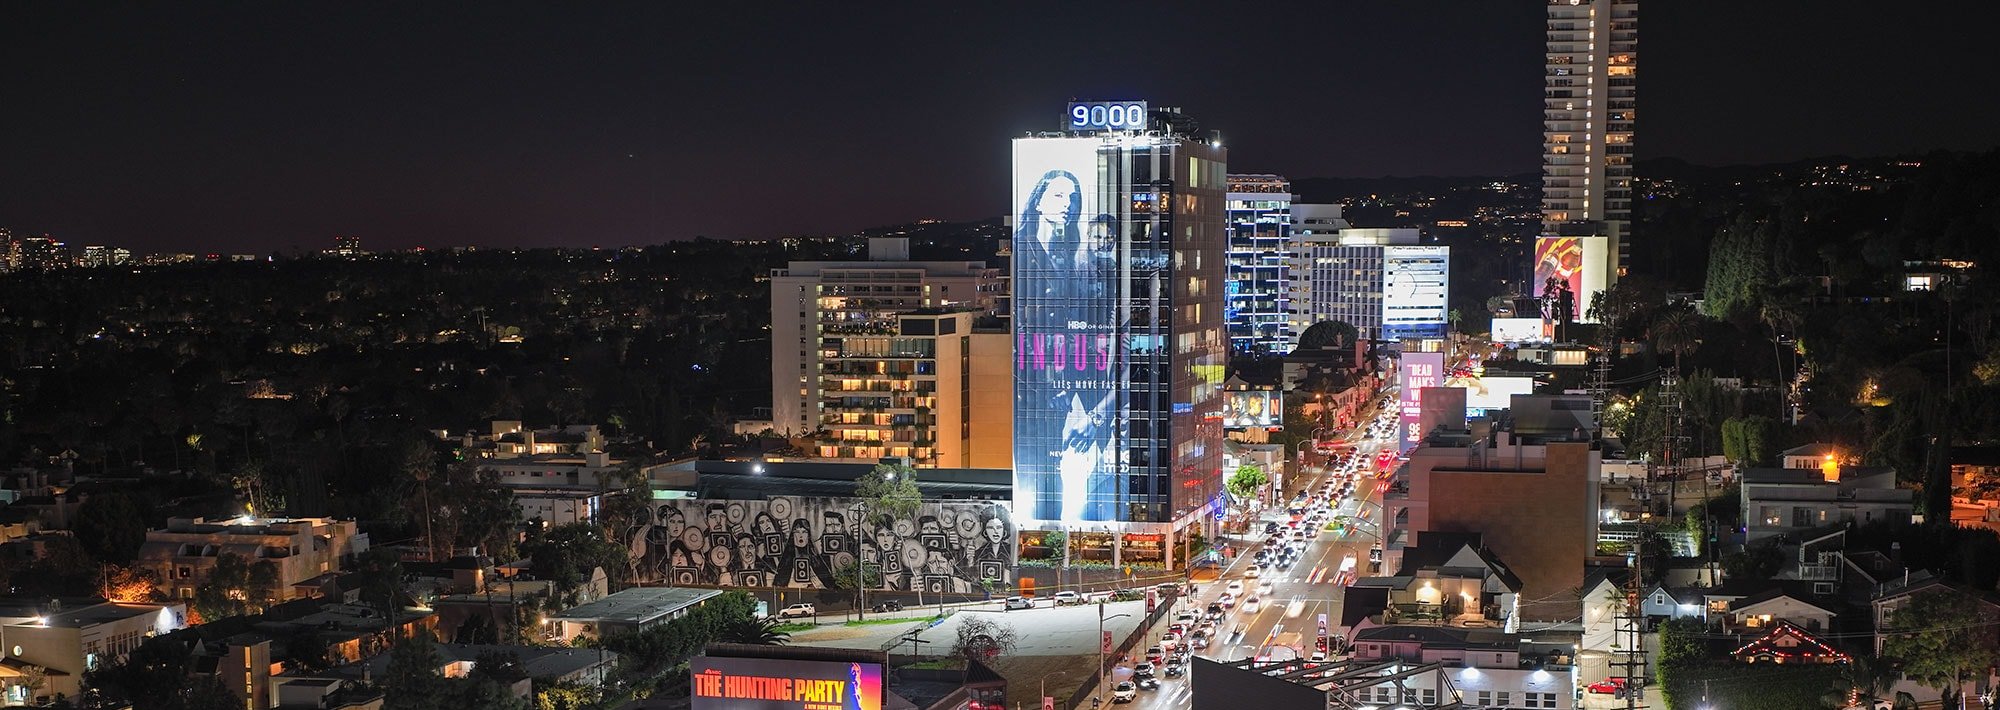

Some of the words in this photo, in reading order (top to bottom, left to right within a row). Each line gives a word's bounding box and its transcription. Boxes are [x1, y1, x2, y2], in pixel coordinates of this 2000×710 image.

[1072, 105, 1143, 126] 9000
[1067, 321, 1087, 330] HBO
[1053, 381, 1070, 389] LIES
[1075, 381, 1097, 389] MOVE
[1270, 399, 1279, 416] N
[695, 674, 722, 697] THE
[724, 676, 792, 701] HUNTING
[795, 679, 845, 703] PARTY
